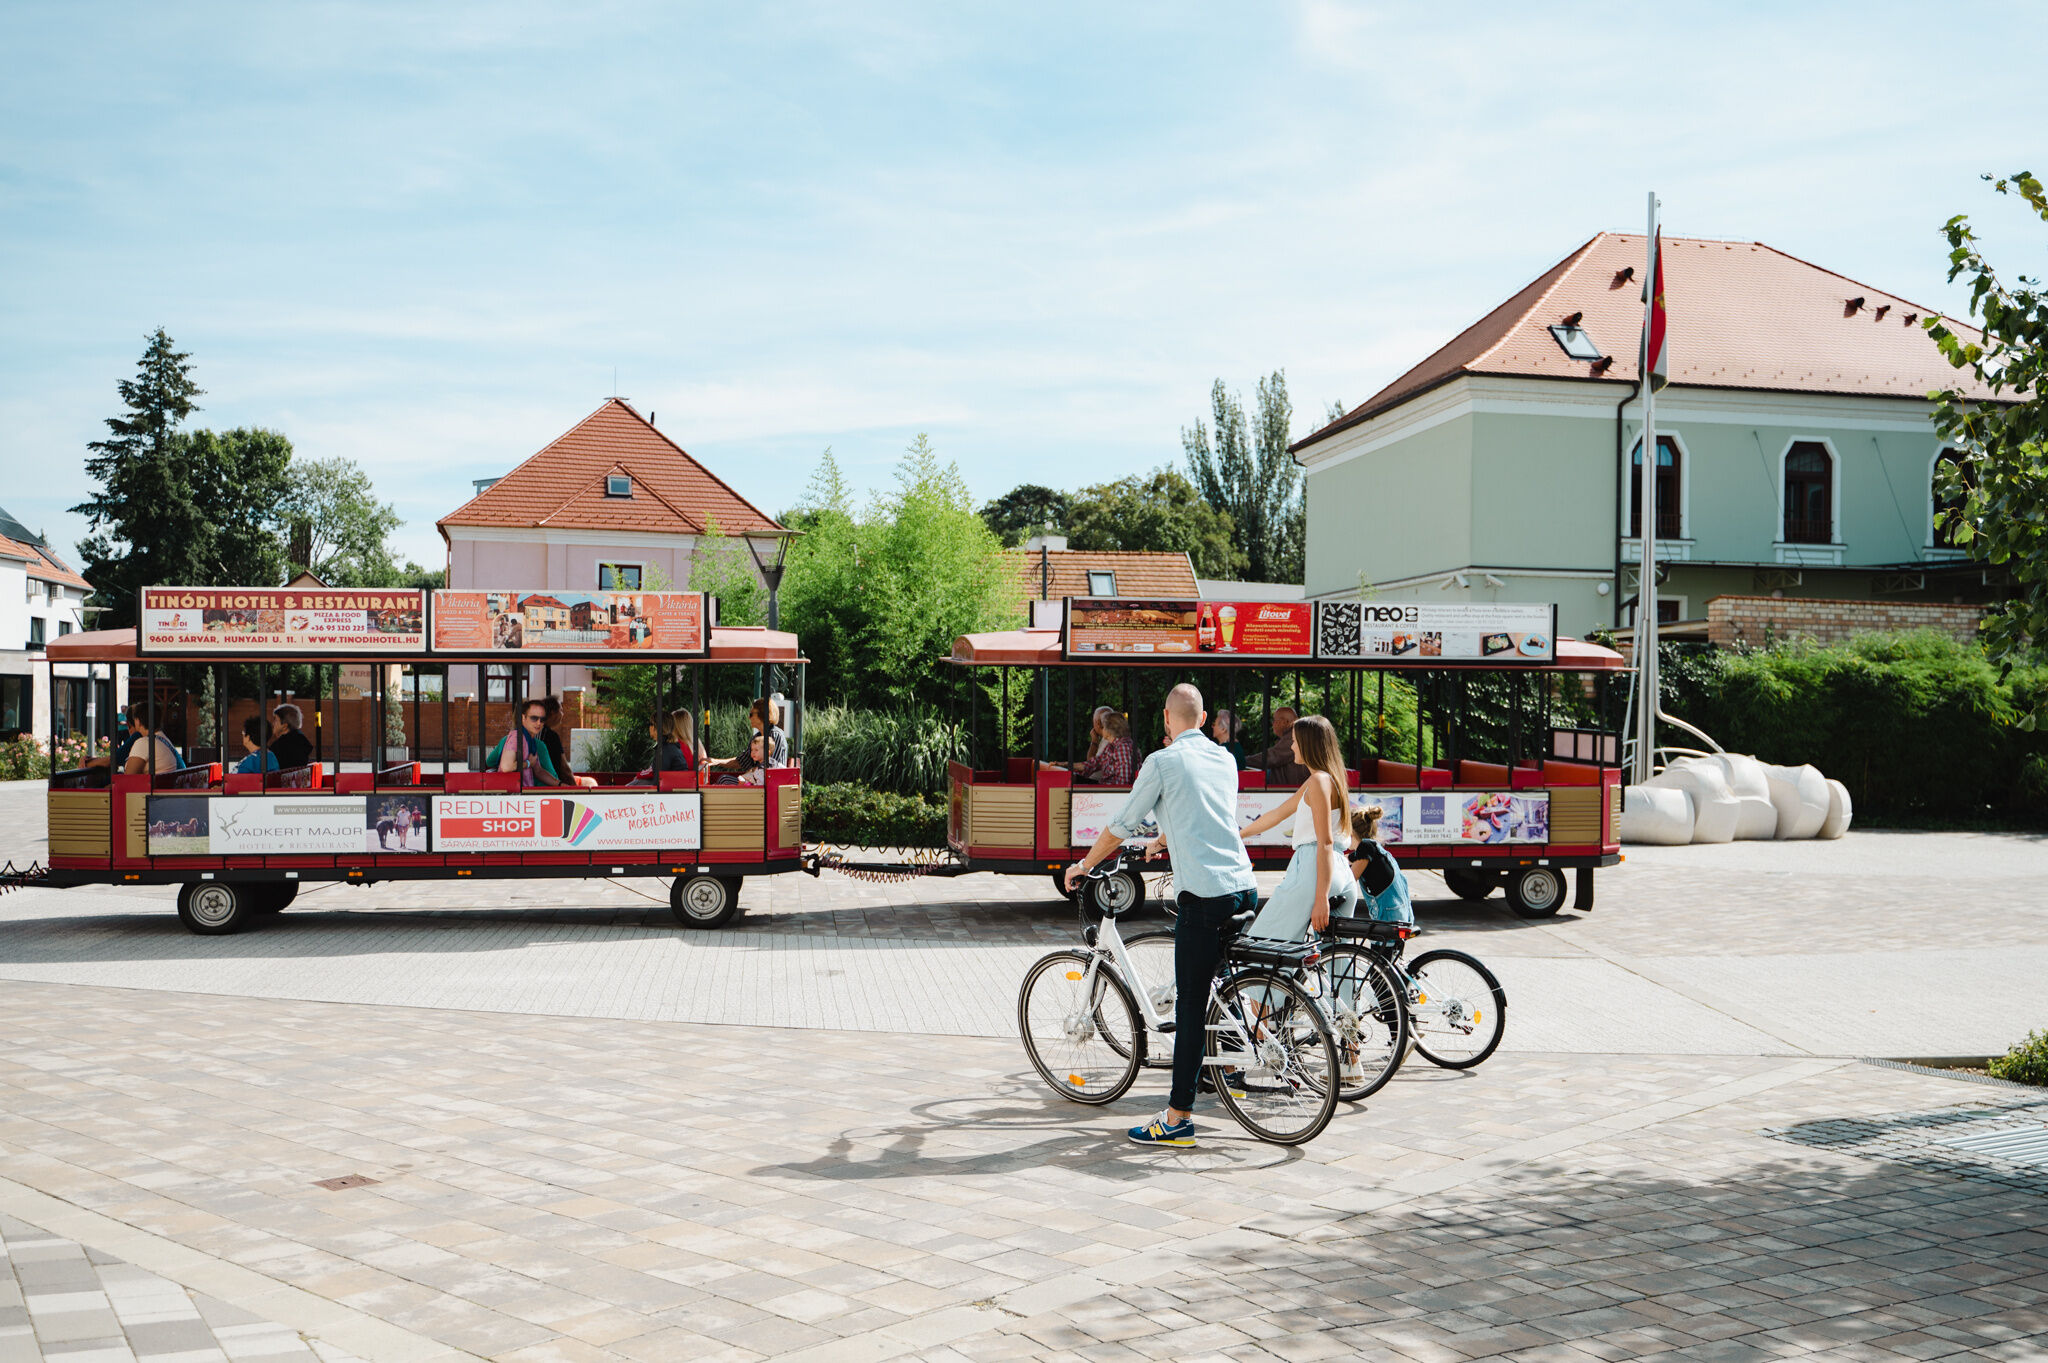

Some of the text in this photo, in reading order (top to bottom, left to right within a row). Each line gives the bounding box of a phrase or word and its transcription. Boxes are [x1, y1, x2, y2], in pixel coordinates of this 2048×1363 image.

[148, 593, 420, 610] TINÓDI HOTEL & RESTAURANT
[1258, 610, 1291, 619] Litovel
[1364, 606, 1403, 622] neo
[149, 635, 175, 643] 9600
[178, 633, 219, 644] SÁRVÁR,
[224, 635, 268, 643] HUNYADI
[272, 635, 282, 643] U.
[308, 636, 420, 644] WWW.TINODIHOTEL.HU
[439, 800, 536, 815] REDLINE
[604, 807, 637, 821] NEKED
[659, 801, 667, 812] A
[482, 820, 532, 832] SHOP
[628, 809, 695, 831] MOBILODNAK!
[233, 826, 363, 837] VADKERT MAJOR
[597, 837, 697, 845] WWW.REDLINESHOP.HU
